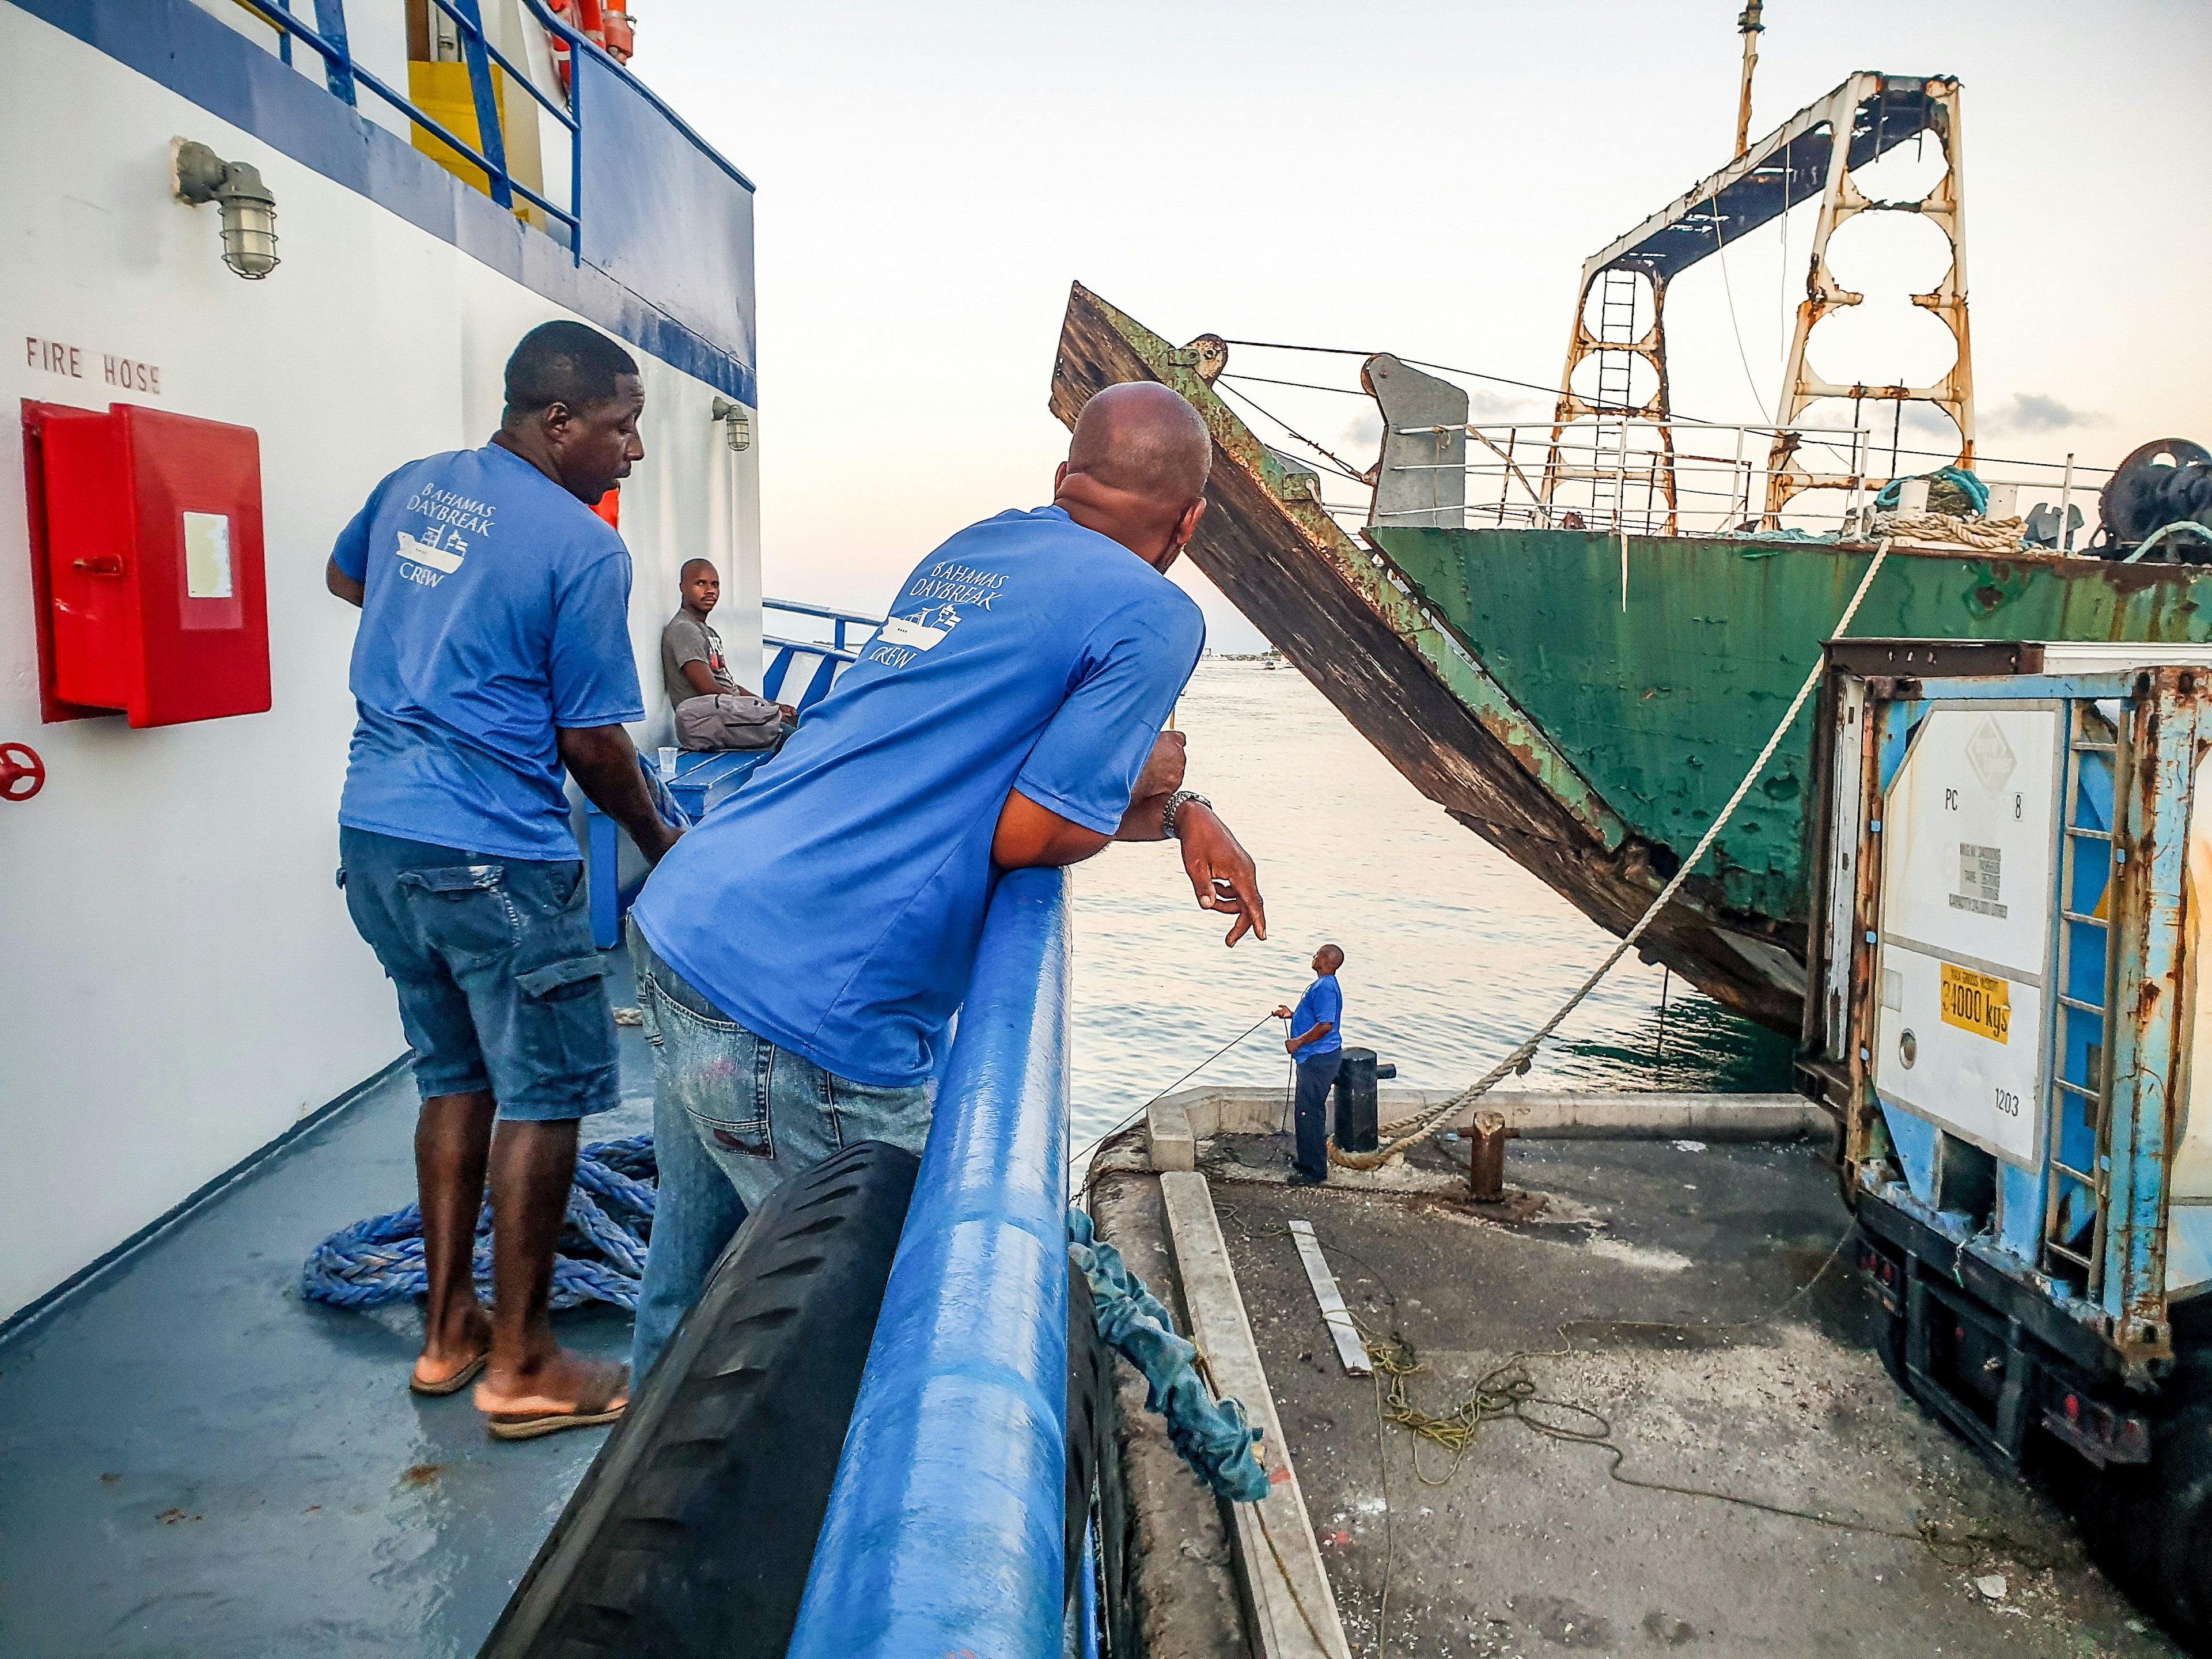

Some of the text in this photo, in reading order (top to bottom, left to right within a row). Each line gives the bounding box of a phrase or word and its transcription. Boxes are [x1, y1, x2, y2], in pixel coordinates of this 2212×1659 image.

[26, 336, 161, 395] FIRE HOSE
[421, 482, 497, 517] BAHAMAS
[406, 495, 496, 537] DAYBREAK
[399, 562, 445, 588] CREW
[930, 561, 1010, 589] BAHAMAS
[908, 578, 1004, 612] DAYBREAK
[868, 646, 918, 670] CREW
[1945, 788, 2021, 819] PC 8
[1995, 1088, 2019, 1117] 1203
